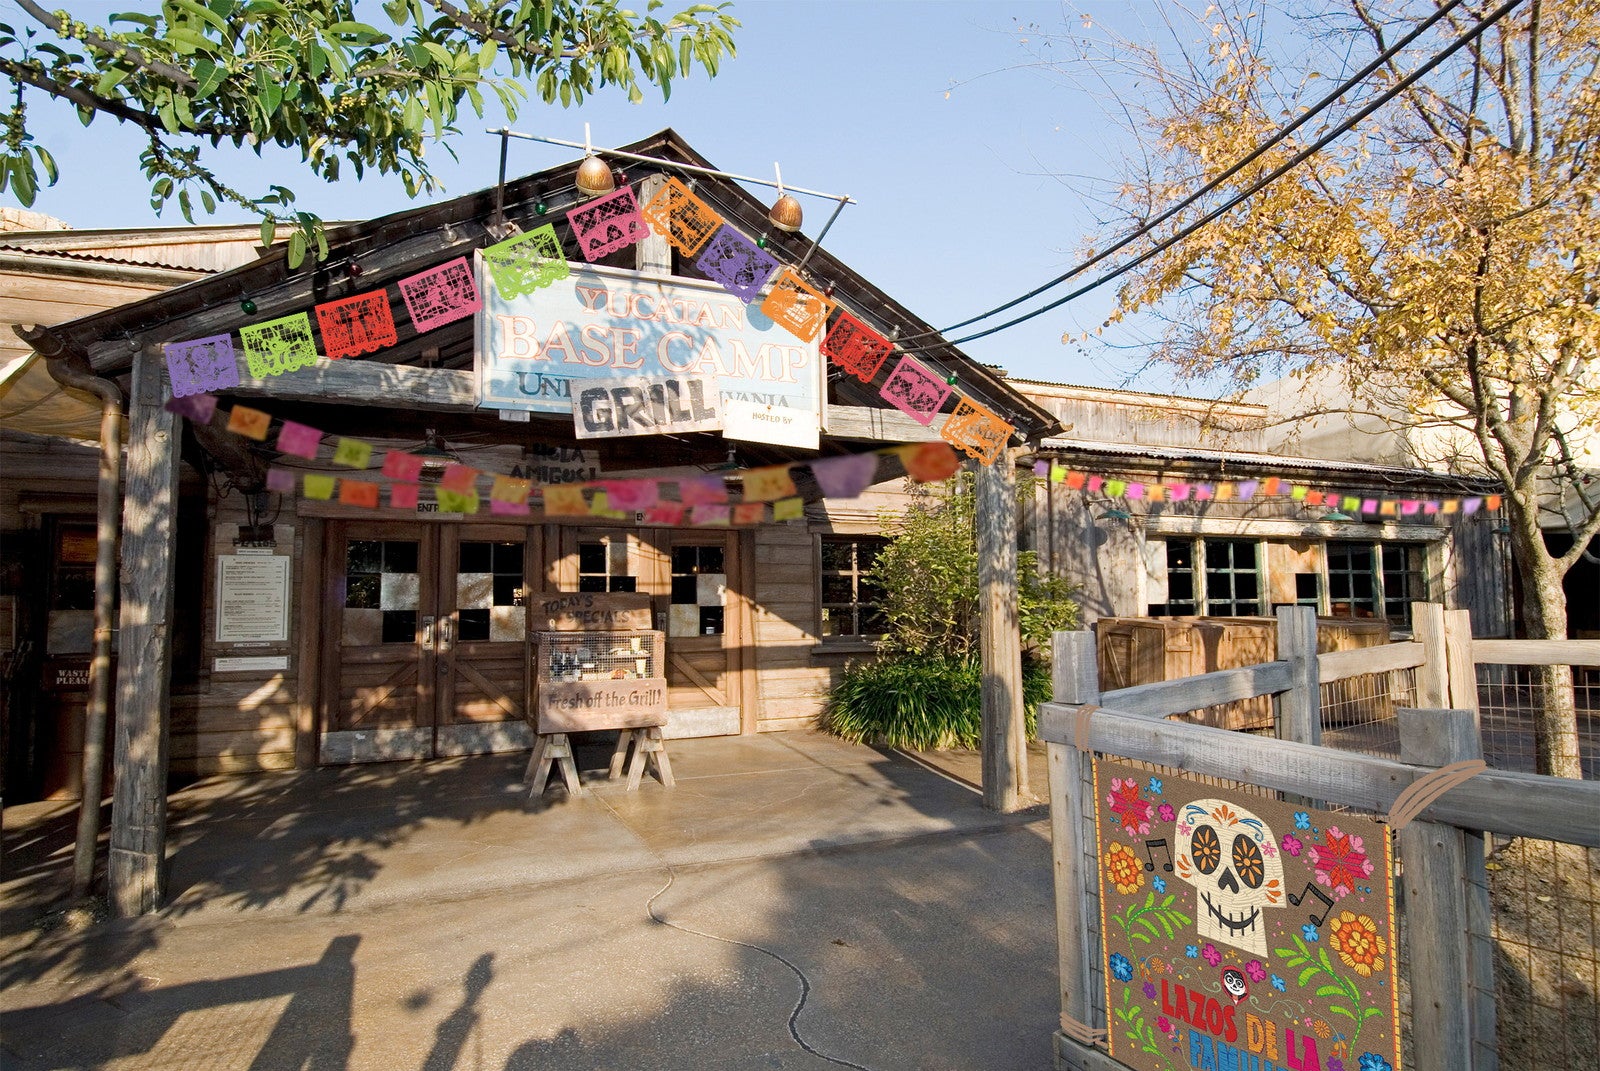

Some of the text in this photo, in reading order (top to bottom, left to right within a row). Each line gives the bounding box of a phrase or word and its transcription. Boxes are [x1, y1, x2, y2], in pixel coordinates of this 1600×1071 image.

[576, 285, 745, 331] YUCATAN
[499, 314, 808, 383] BASE CAMP
[579, 378, 717, 434] GRILL
[752, 411, 794, 425] HOSTED BY
[566, 609, 631, 624] SPECIALS
[548, 688, 662, 710] Fresh off the Grill!
[1161, 978, 1238, 1043] LAZOS
[1246, 1012, 1321, 1071] DE LA
